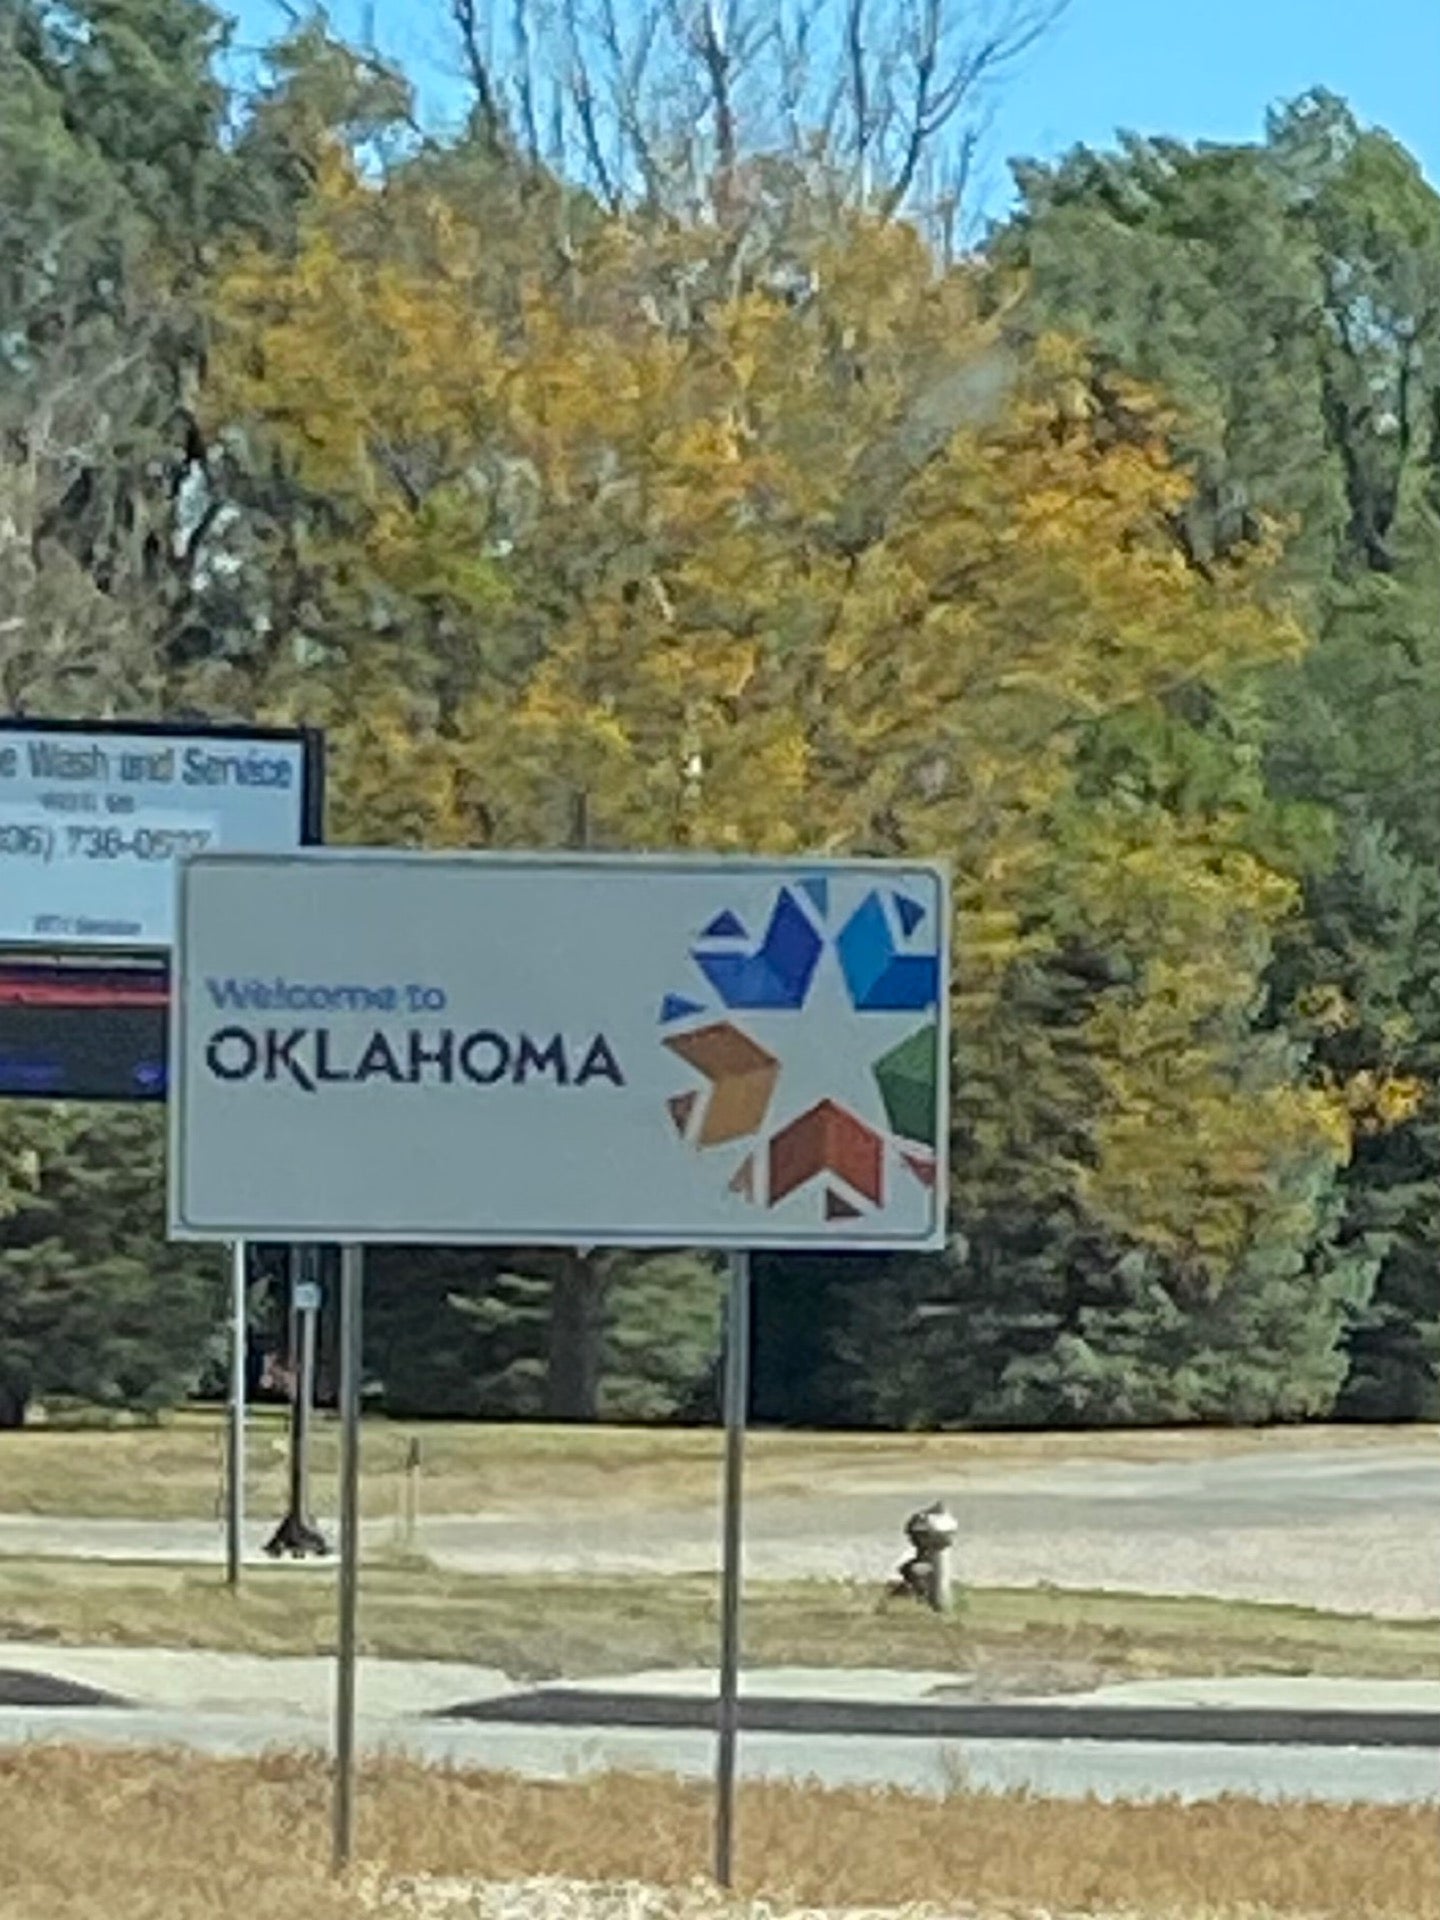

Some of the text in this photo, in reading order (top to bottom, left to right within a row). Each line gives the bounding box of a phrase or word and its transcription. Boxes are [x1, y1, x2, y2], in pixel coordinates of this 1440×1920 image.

[182, 747, 292, 787] Service
[207, 977, 446, 1011] Welcome to
[206, 1025, 627, 1092] OKLAHOMA
